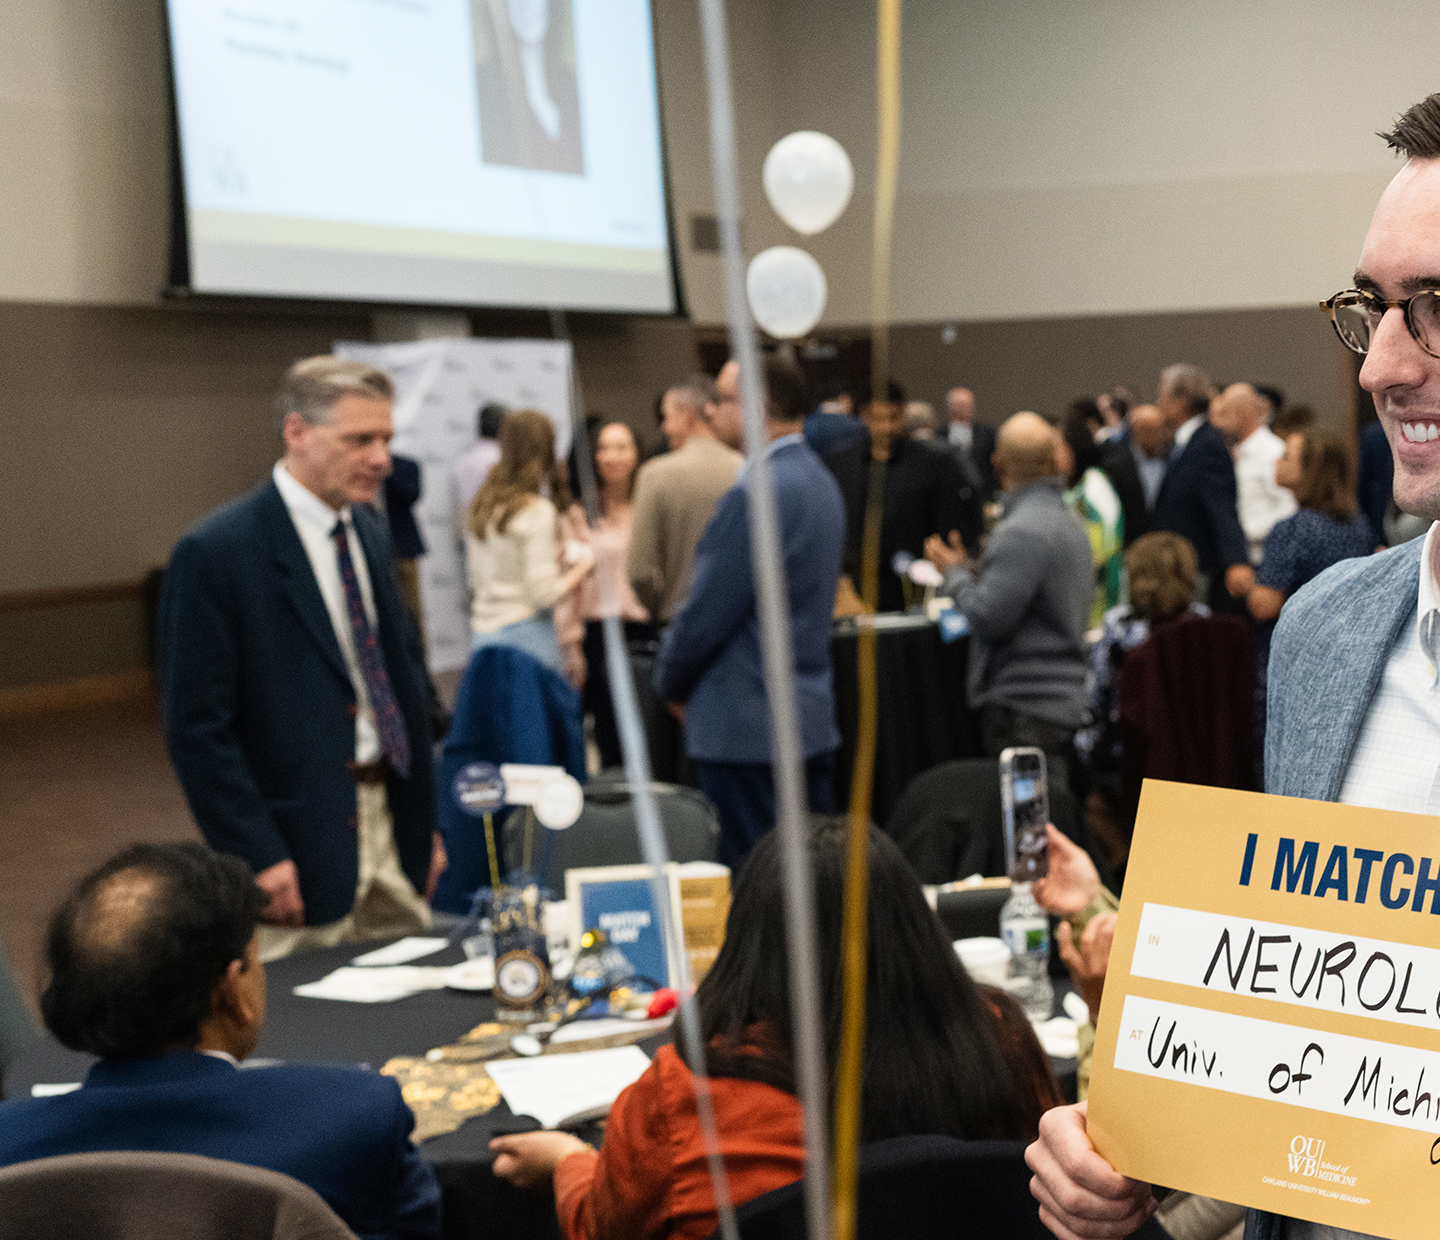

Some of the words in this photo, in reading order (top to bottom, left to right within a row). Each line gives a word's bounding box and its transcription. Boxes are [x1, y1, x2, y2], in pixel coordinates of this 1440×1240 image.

[1239, 833, 1258, 886] I
[1148, 934, 1160, 947] IN
[1129, 1028, 1144, 1041] AT
[1147, 1016, 1223, 1079] Univ.
[1268, 1042, 1324, 1095] of
[1290, 1135, 1322, 1159] OU
[1287, 1153, 1317, 1177] WB
[1319, 1161, 1341, 1172] School
[1340, 1166, 1350, 1175] of
[1262, 1176, 1287, 1188] OAKLAND
[1288, 1182, 1318, 1194] UNIVERSITY
[1318, 1188, 1343, 1200] WILLIAM
[1318, 1170, 1358, 1187] MEDICINE
